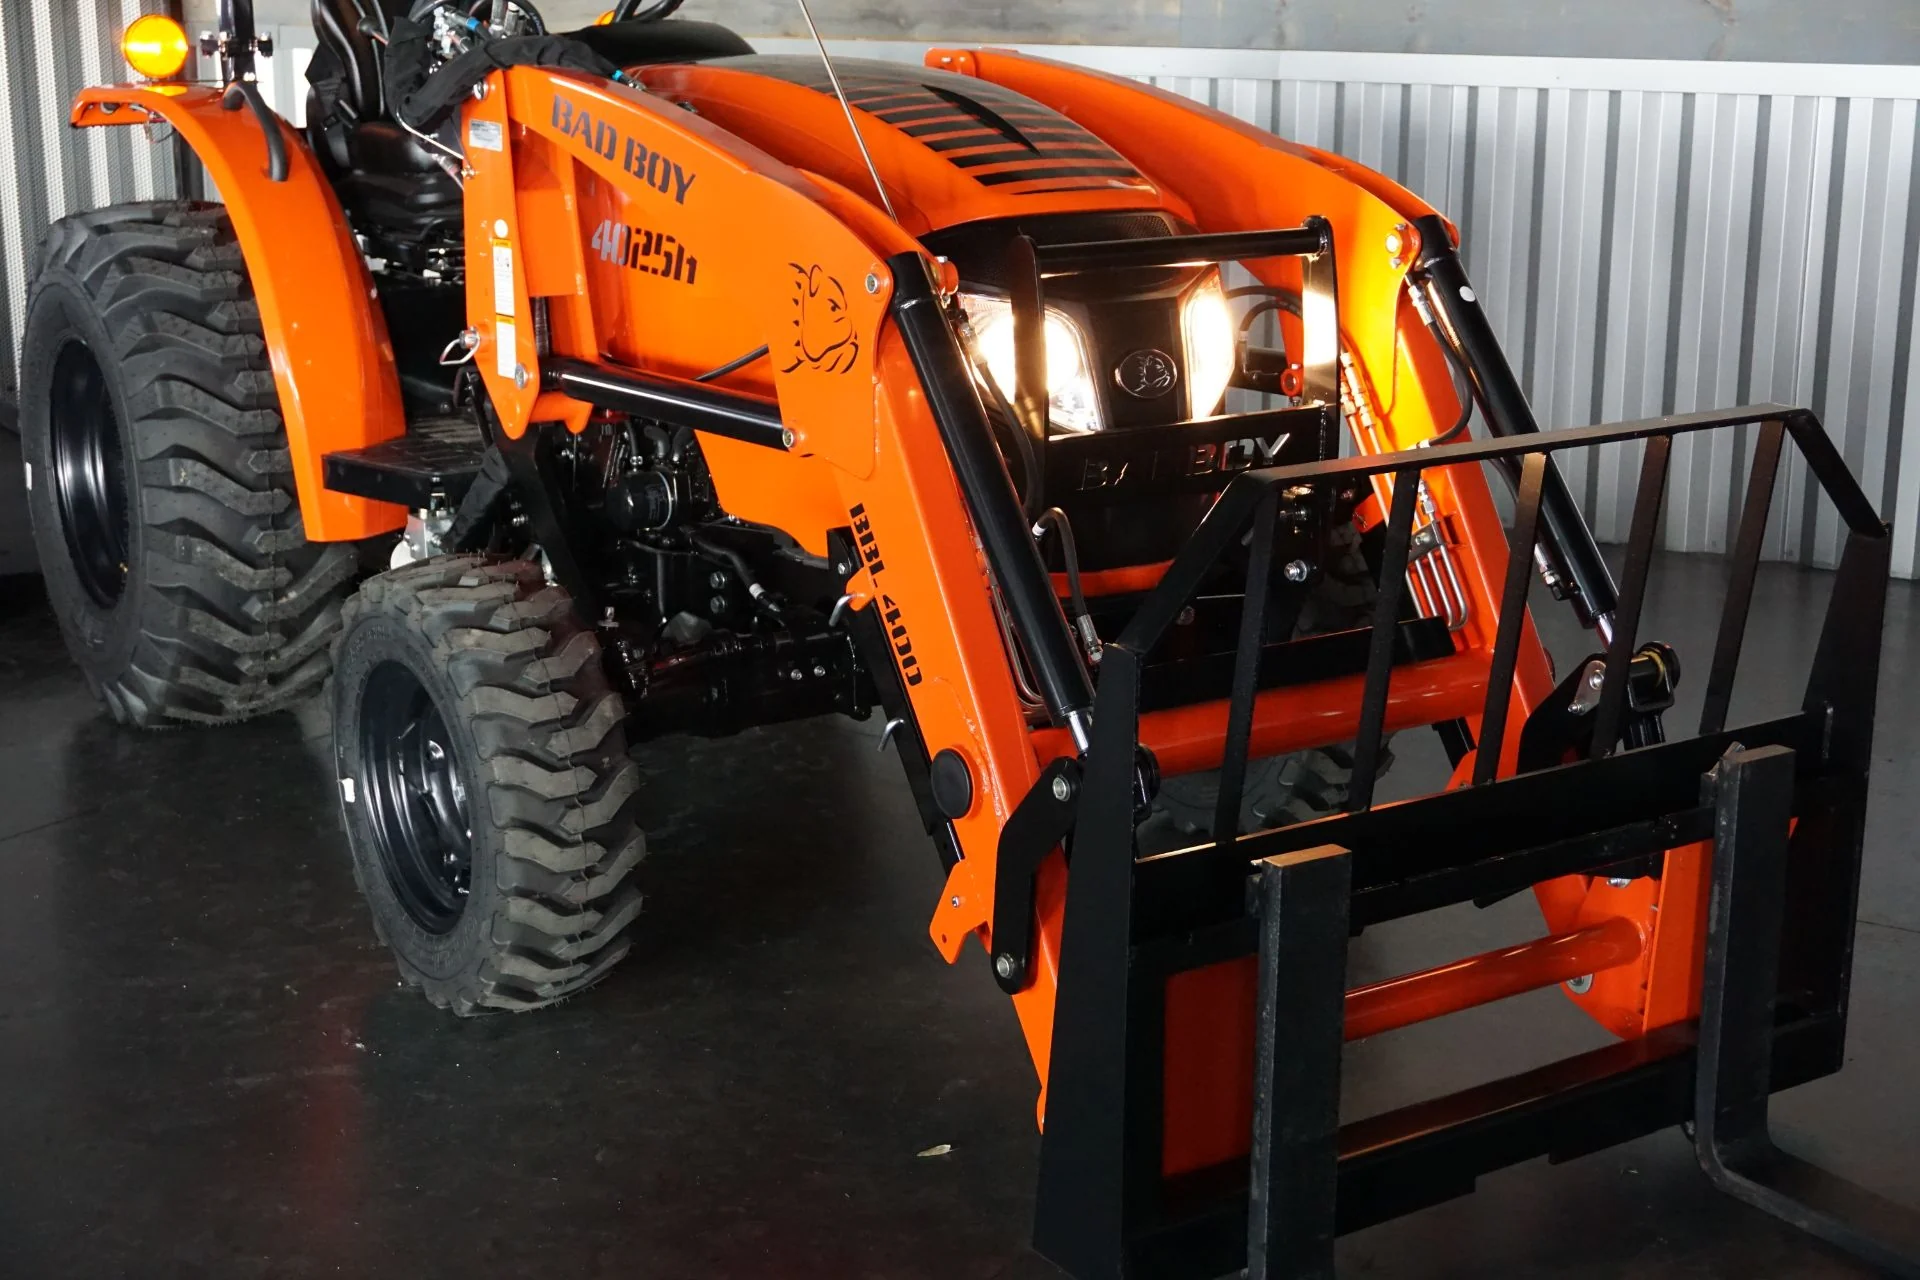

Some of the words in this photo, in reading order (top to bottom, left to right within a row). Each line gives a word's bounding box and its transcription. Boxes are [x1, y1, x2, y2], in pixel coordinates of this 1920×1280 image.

[551, 94, 618, 162] BAD
[623, 136, 697, 206] BOY
[1185, 432, 1291, 478] BOY
[882, 594, 923, 687] 400
